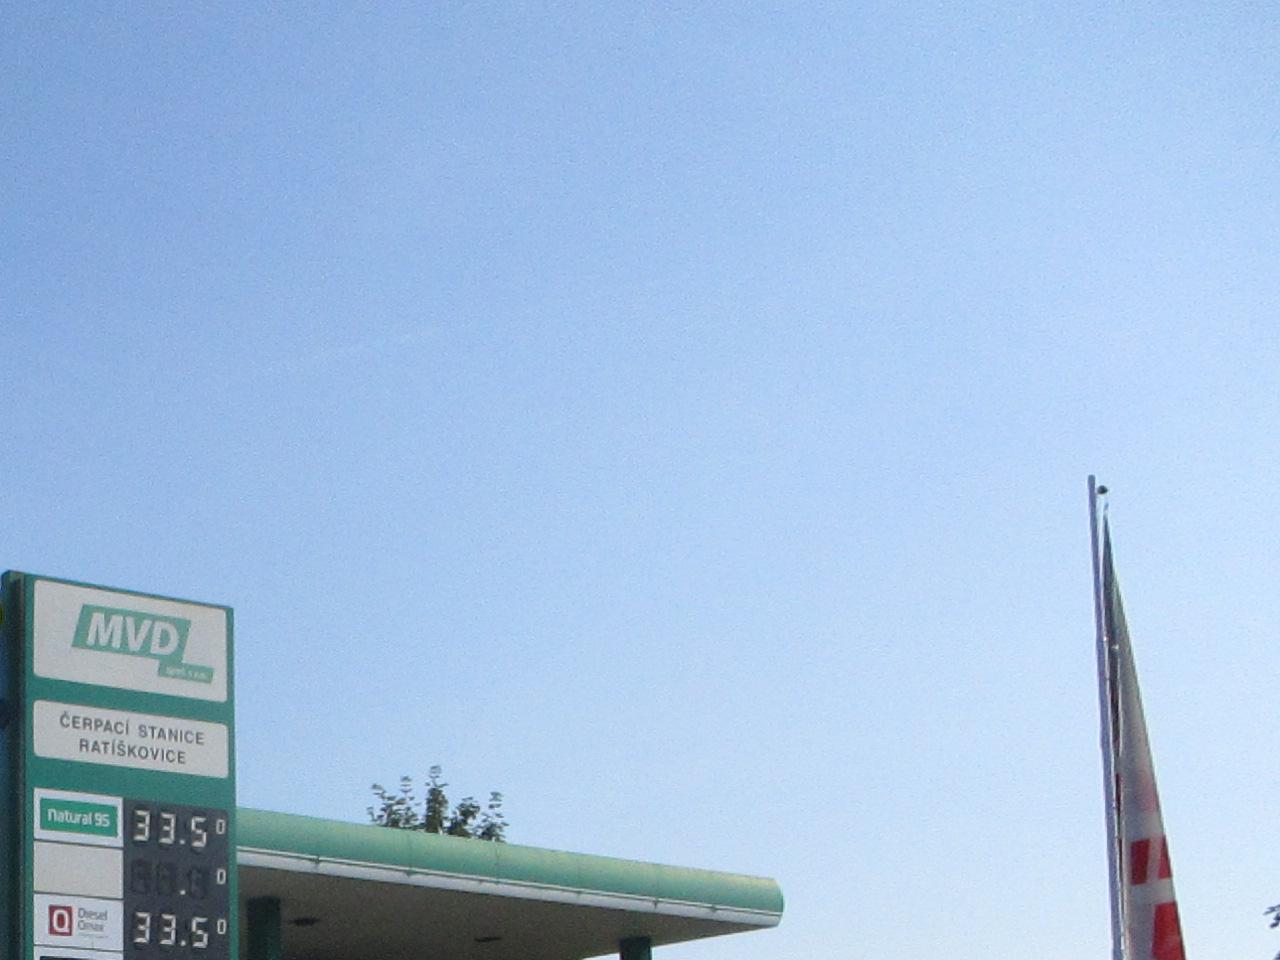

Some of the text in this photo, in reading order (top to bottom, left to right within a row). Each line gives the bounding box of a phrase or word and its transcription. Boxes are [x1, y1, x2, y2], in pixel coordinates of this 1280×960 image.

[86, 612, 179, 656] MVD
[59, 710, 205, 746] ČERPACÍ STANICE
[79, 737, 187, 765] RATÍŠKOVICE
[94, 813, 111, 828] 95
